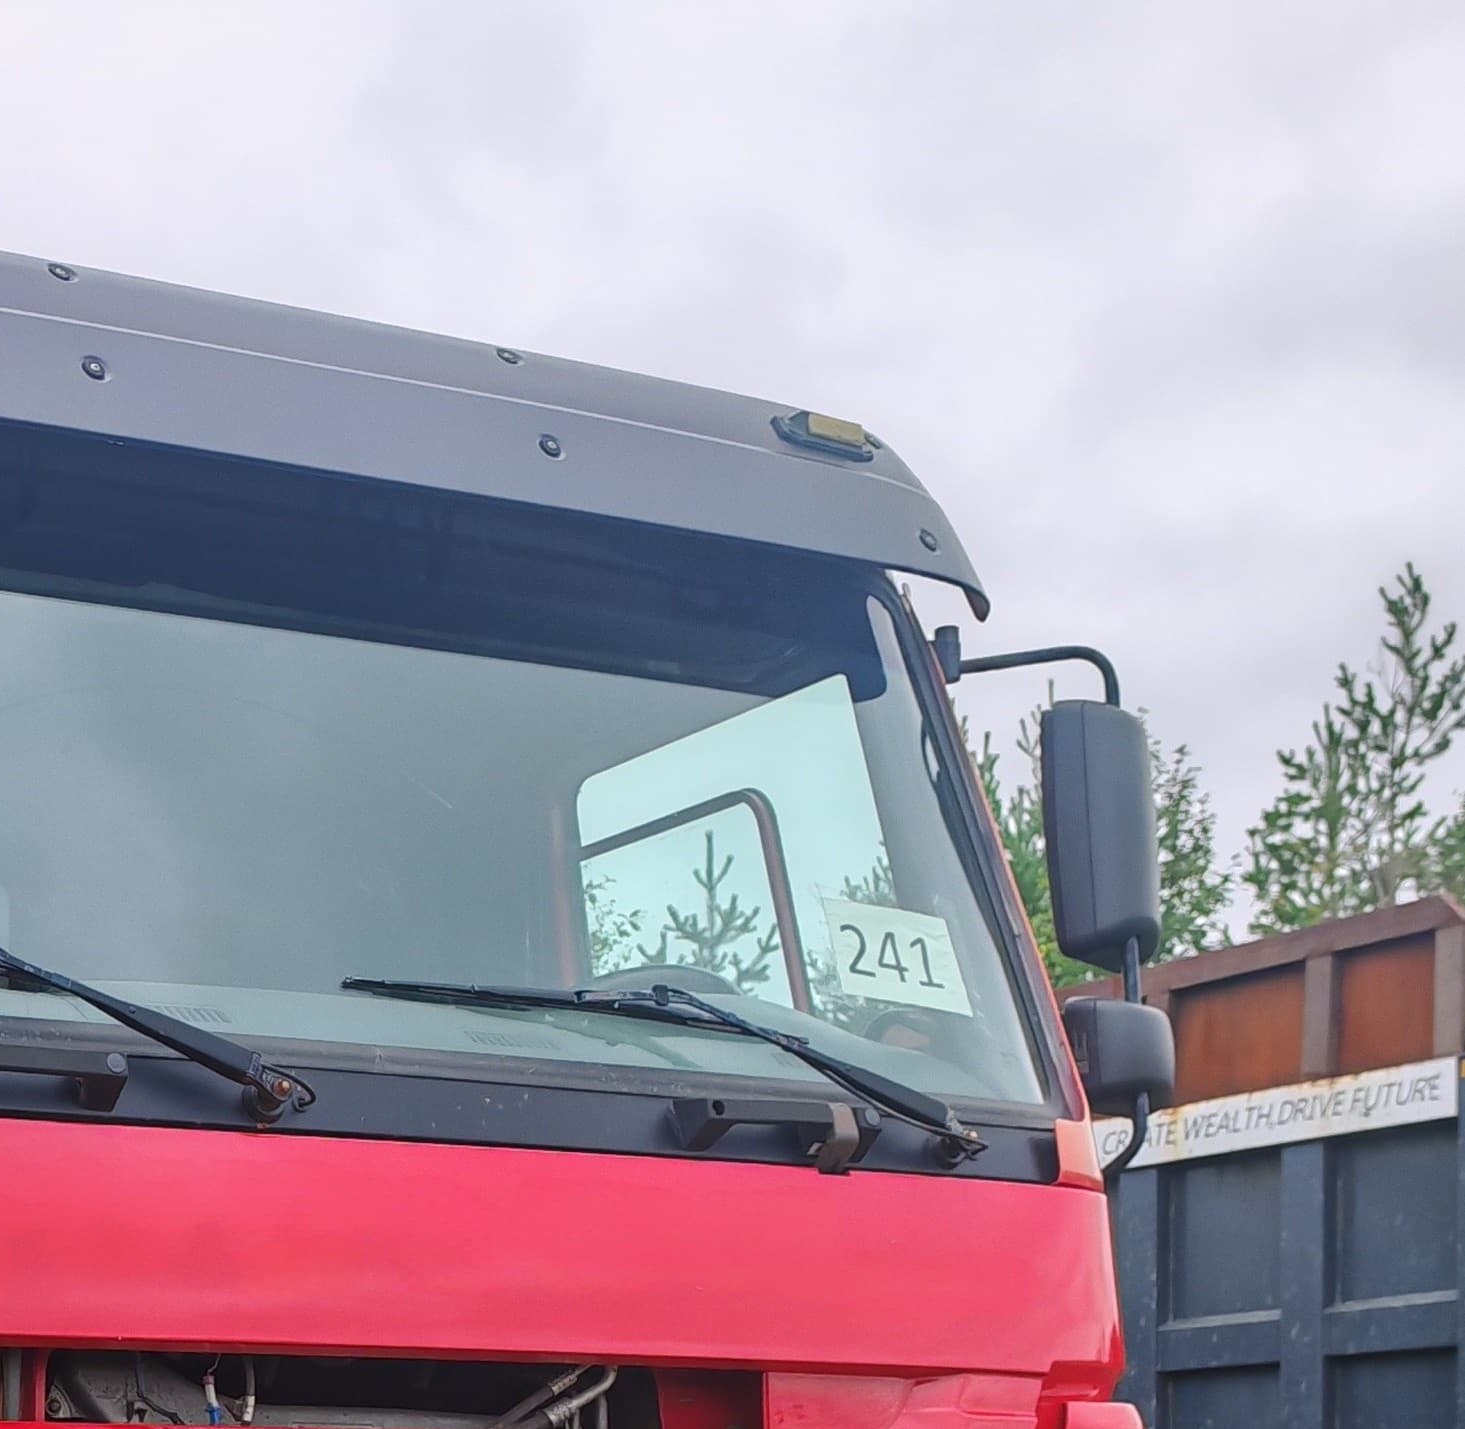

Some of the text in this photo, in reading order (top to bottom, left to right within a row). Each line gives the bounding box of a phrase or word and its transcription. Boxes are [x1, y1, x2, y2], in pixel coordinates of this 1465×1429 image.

[840, 923, 945, 989] 241
[1103, 1119, 1177, 1155] CRATE
[1349, 1073, 1441, 1112] FUTURE
